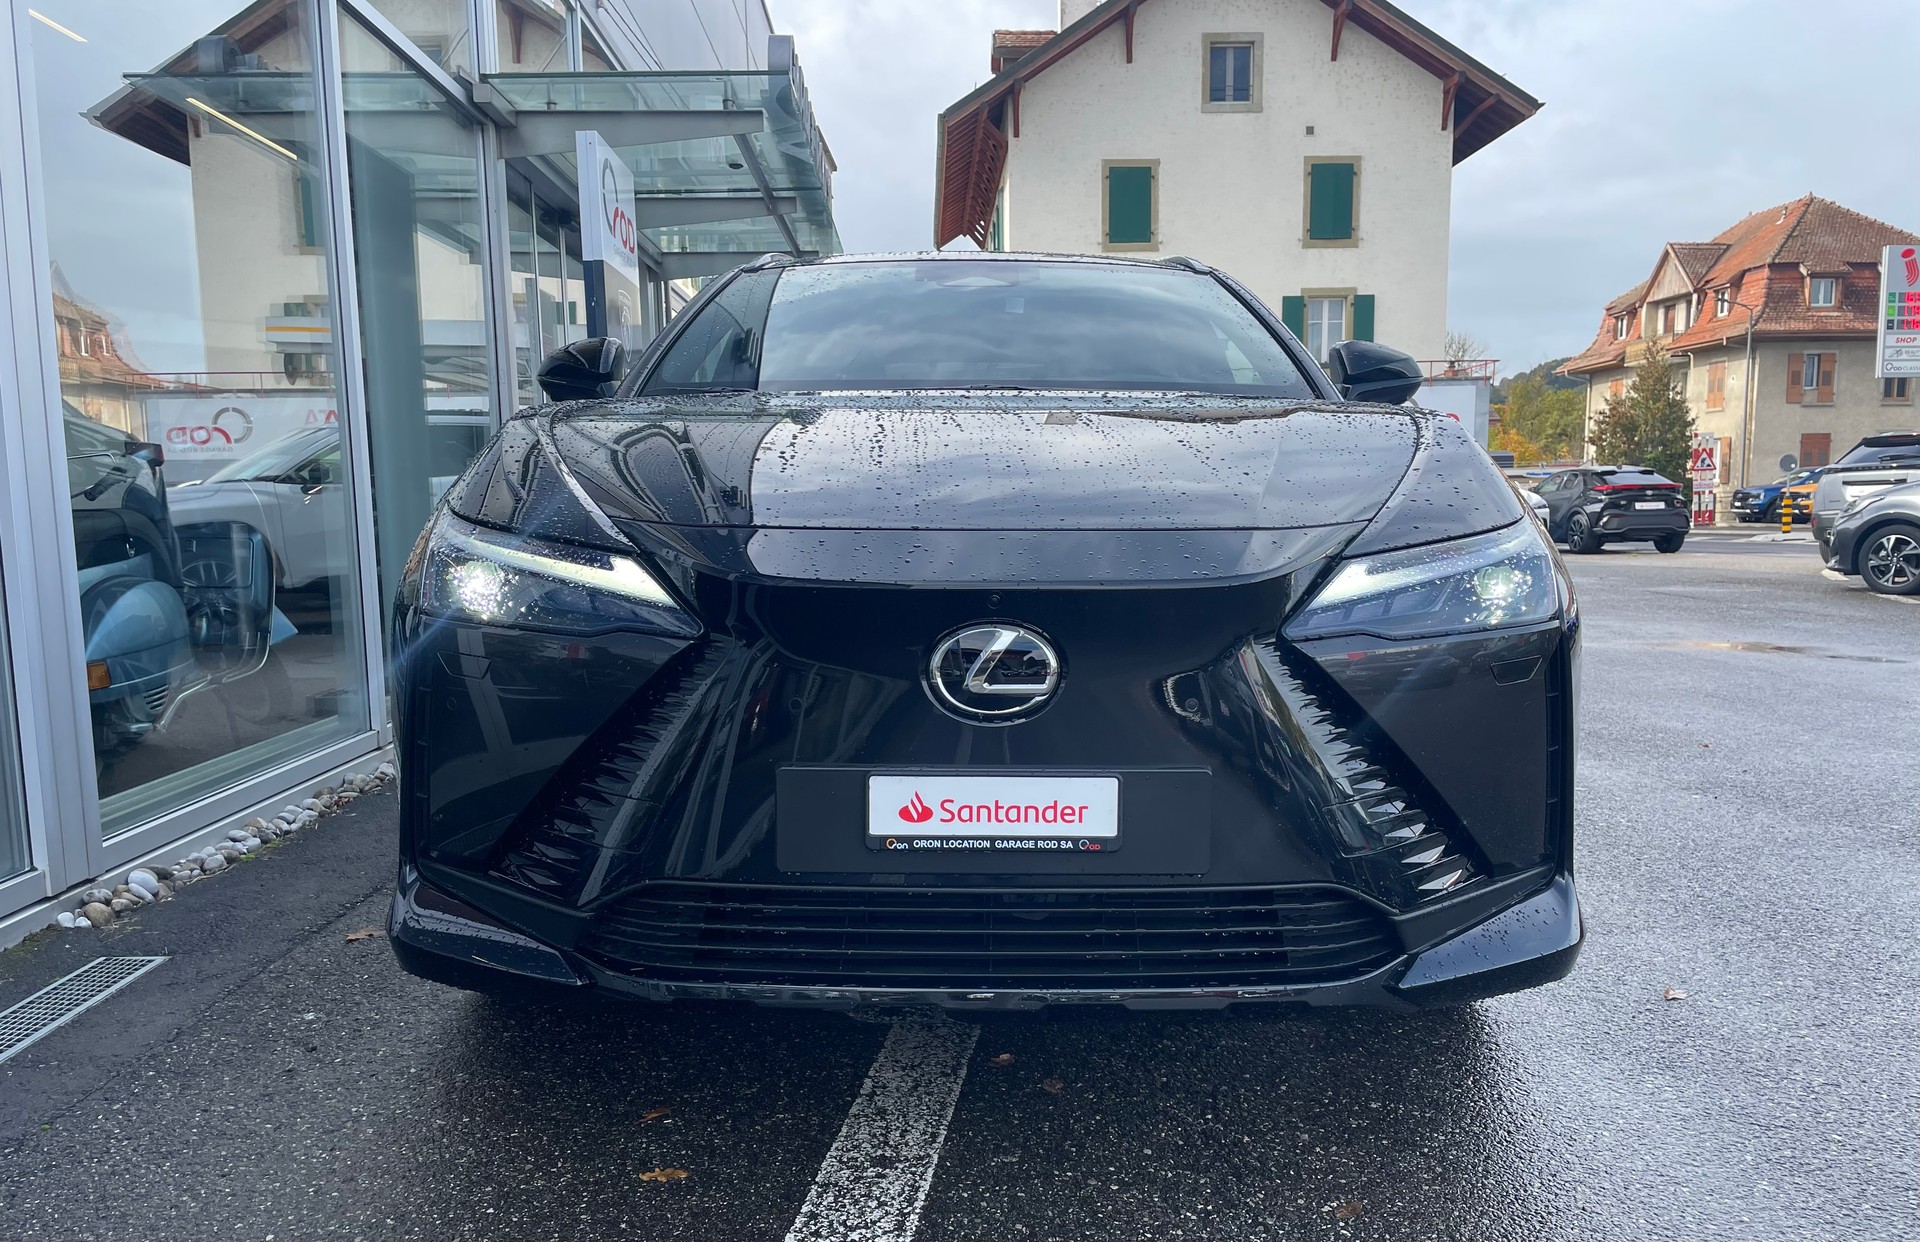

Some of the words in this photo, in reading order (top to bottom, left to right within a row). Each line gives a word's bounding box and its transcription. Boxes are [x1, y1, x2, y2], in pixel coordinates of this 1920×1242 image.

[939, 799, 1089, 824] Santander
[913, 839, 941, 848] ORON
[943, 840, 991, 848] LOCATION
[995, 840, 1035, 849] GARAGE
[1037, 841, 1058, 849] ROD
[1060, 841, 1074, 849] SA
